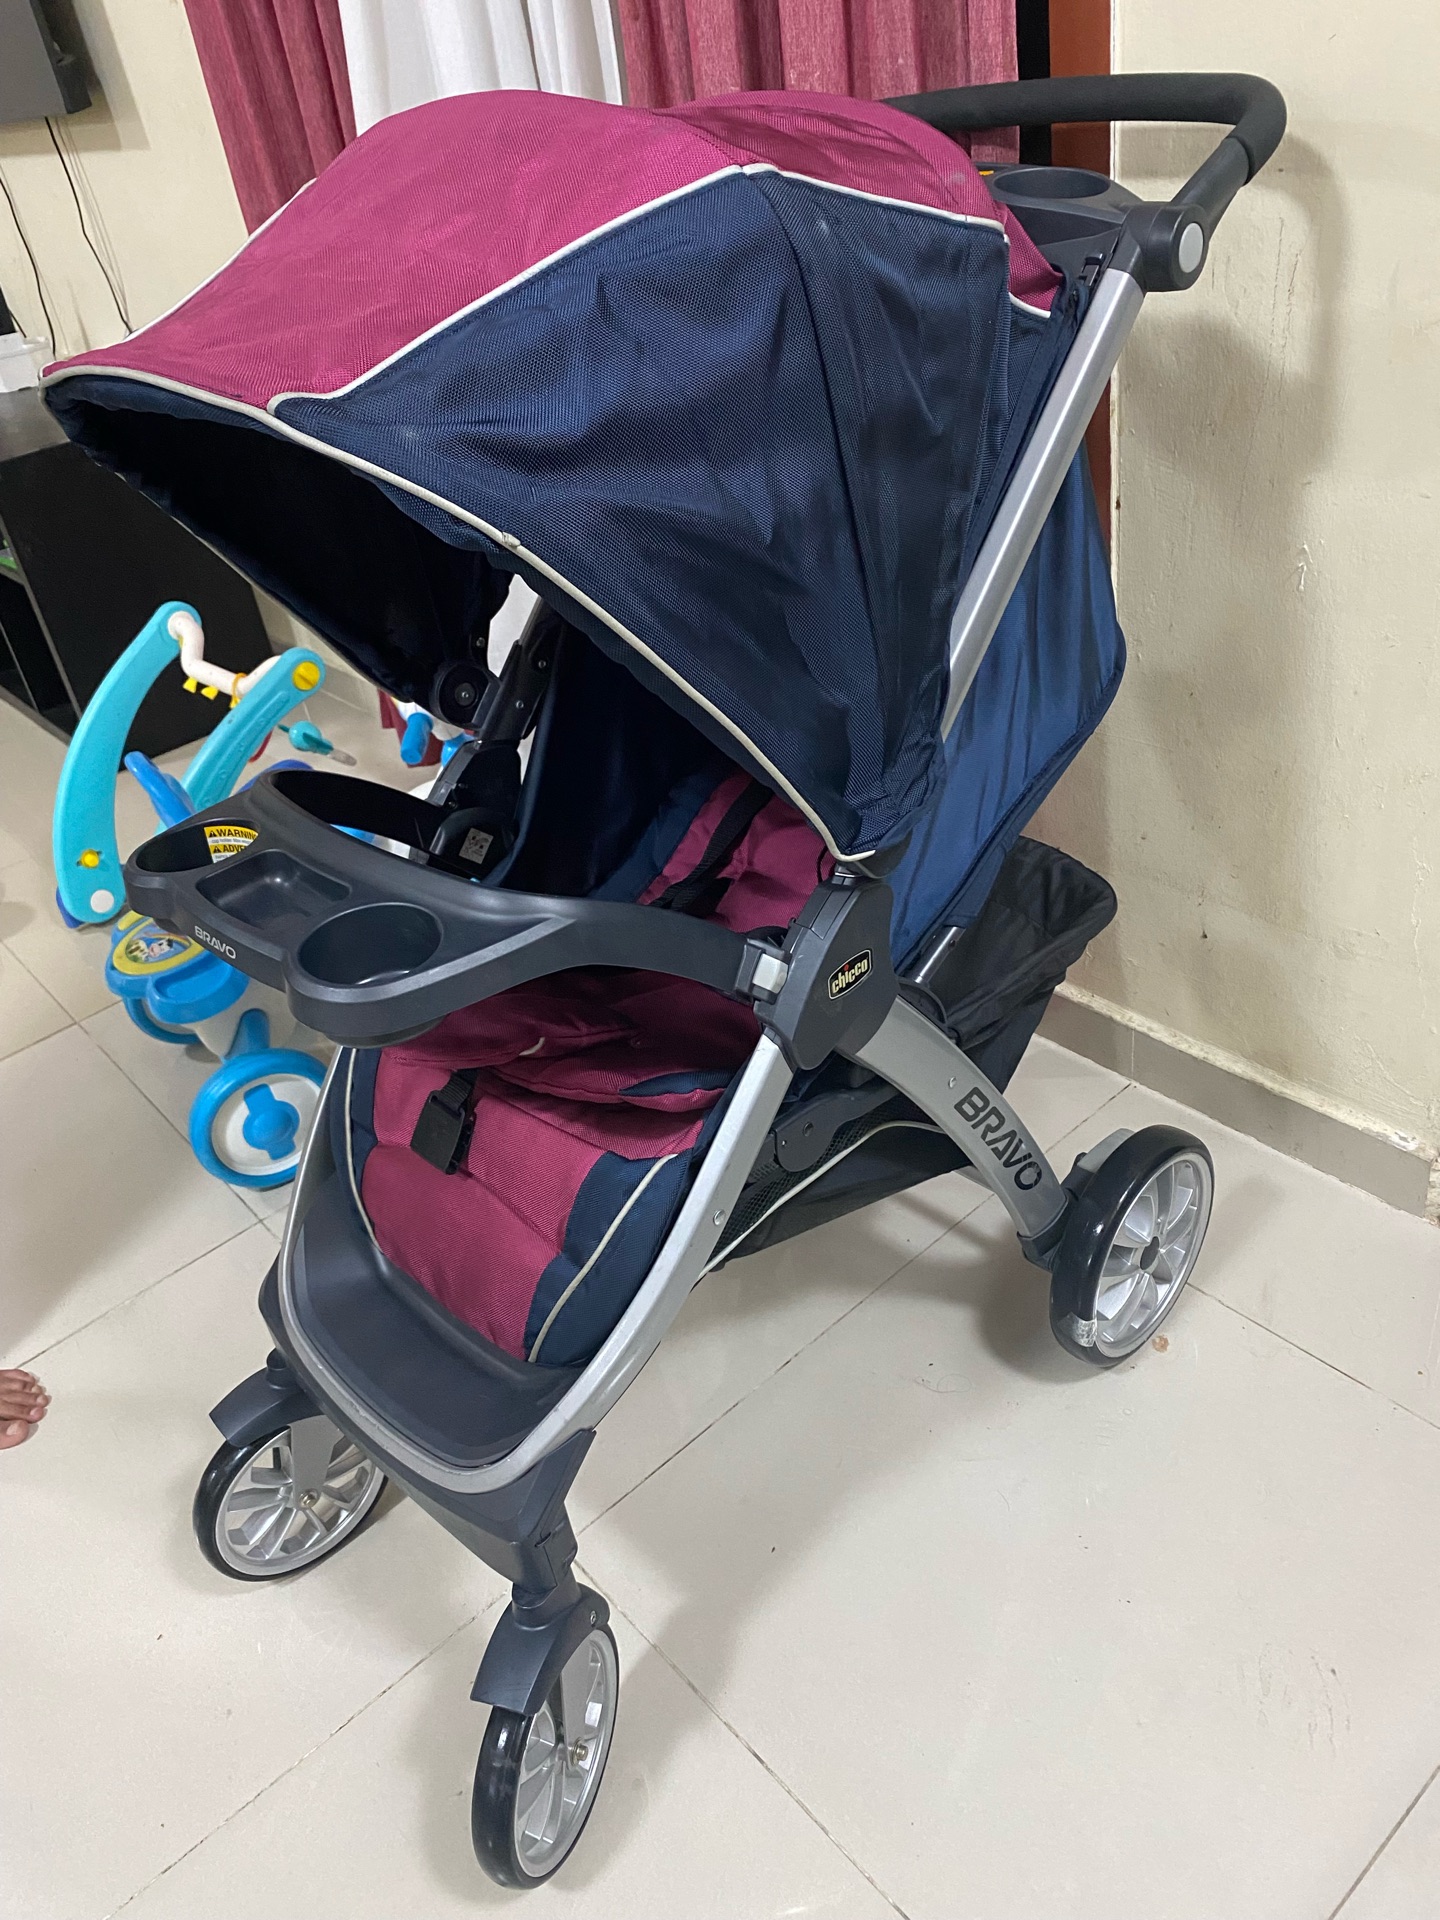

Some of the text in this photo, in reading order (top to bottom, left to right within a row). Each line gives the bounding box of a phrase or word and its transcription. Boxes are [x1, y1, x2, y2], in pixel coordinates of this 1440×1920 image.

[194, 925, 237, 959] BRAVO
[831, 958, 868, 994] chicco
[954, 1086, 1042, 1191] BRAVO
